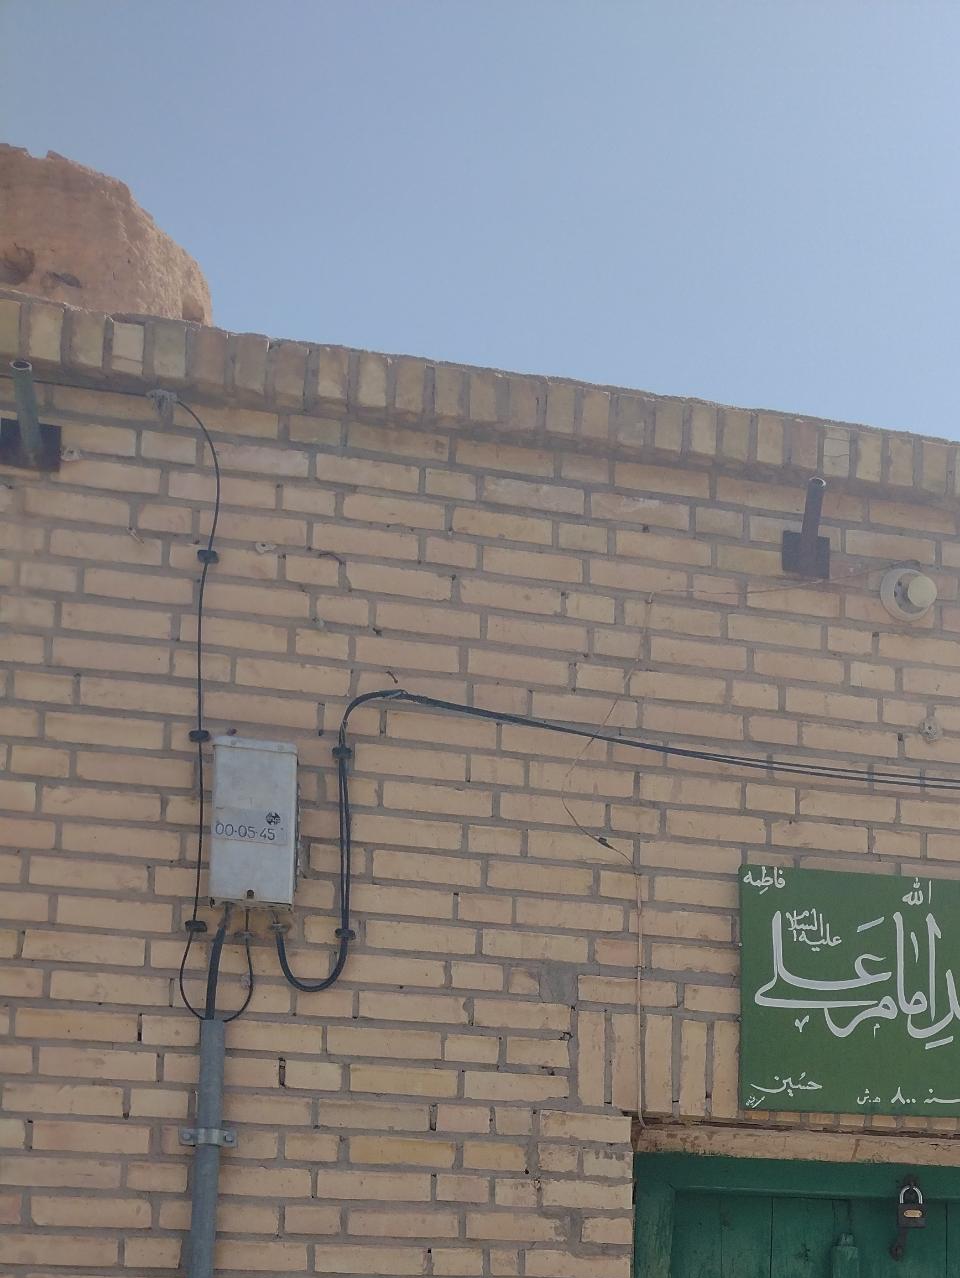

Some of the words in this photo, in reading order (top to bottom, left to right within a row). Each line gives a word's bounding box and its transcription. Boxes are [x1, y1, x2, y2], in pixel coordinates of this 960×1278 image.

[743, 866, 786, 894] فاطمه
[902, 877, 932, 905] الله
[750, 1072, 823, 1097] حسین
